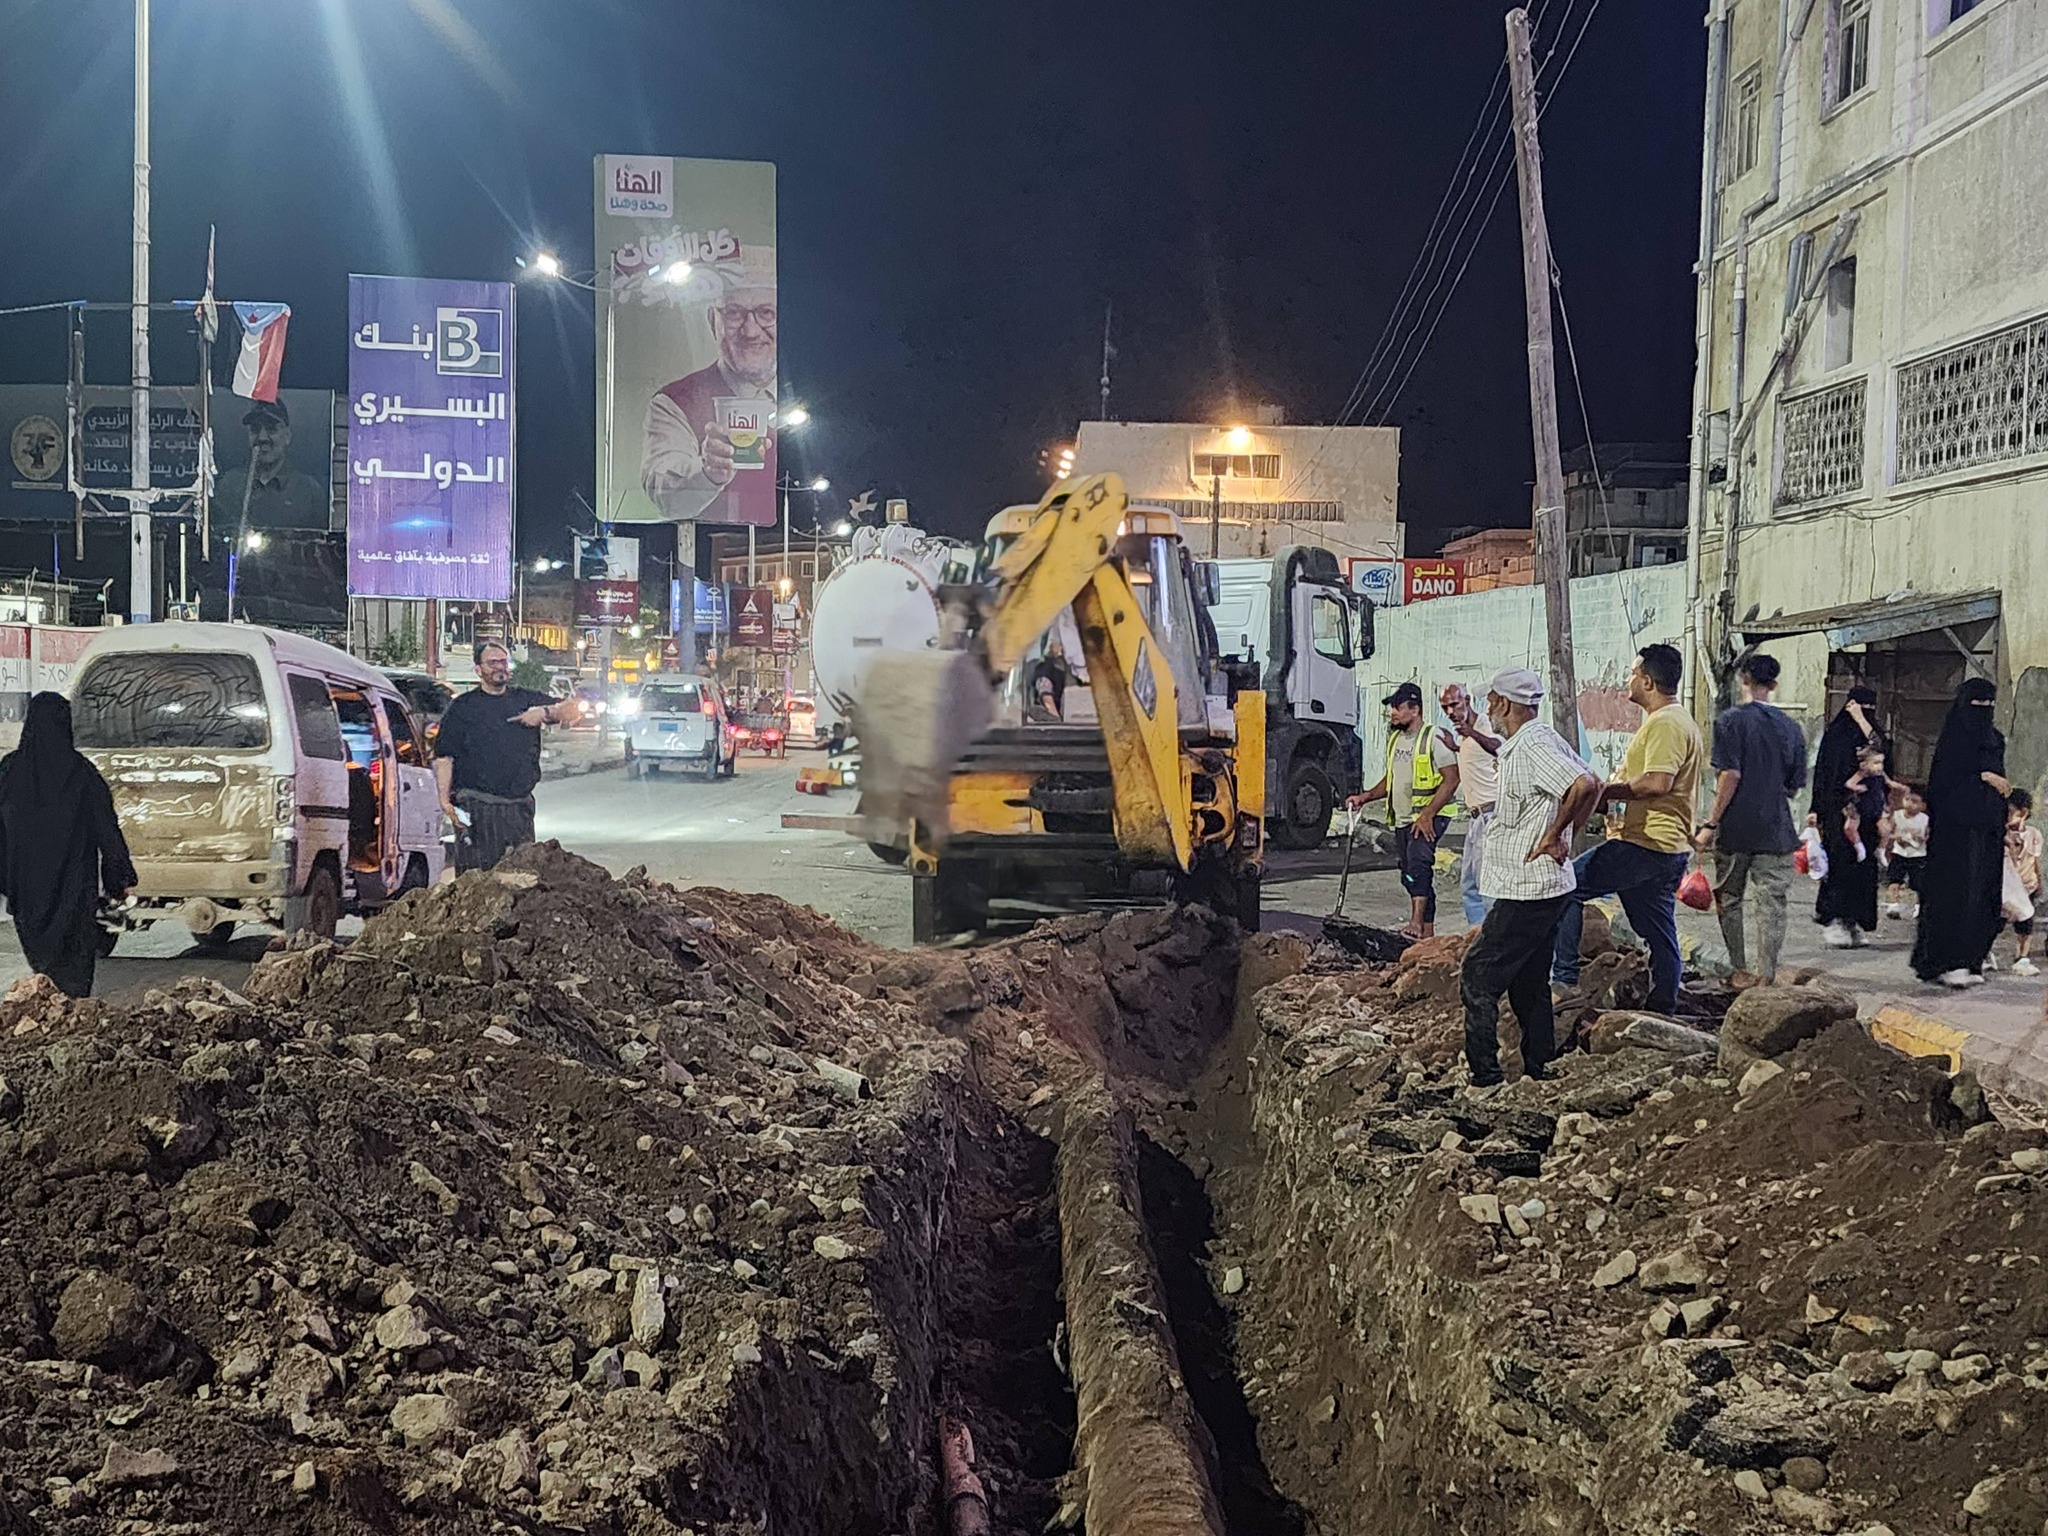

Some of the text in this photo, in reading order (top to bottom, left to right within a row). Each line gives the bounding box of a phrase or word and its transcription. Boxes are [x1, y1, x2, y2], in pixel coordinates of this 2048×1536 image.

[616, 164, 661, 195] الهنا
[640, 199, 668, 212] صحة
[700, 228, 735, 262] كل
[354, 323, 433, 360] بنك
[149, 413, 174, 430] الرئي
[354, 392, 505, 426] البسيري
[729, 410, 758, 430] الهنا
[354, 453, 504, 489] الدولي
[357, 549, 490, 565] ثقة مصرفية بآفاق عالمية
[1412, 578, 1455, 594] DANO
